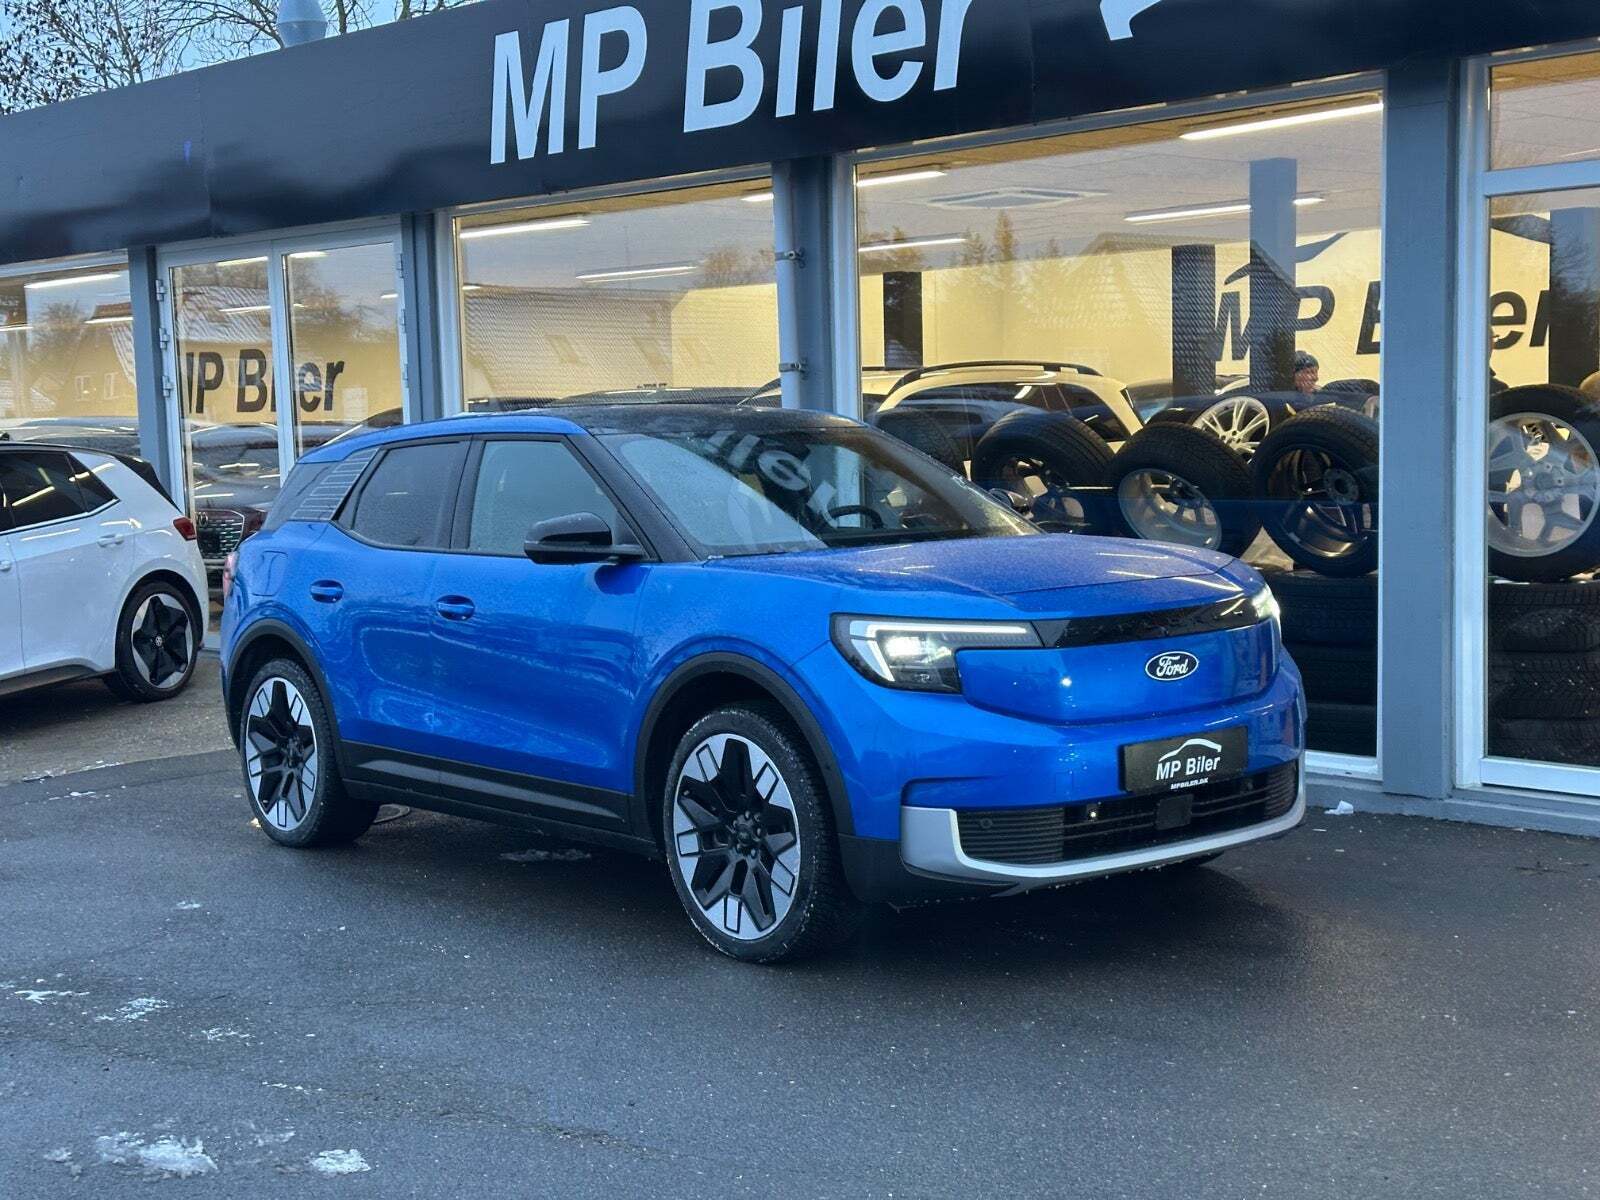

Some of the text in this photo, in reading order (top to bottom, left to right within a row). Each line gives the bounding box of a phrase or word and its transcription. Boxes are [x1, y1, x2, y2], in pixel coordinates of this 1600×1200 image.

[490, 0, 973, 164] MP Biler
[237, 348, 345, 413] Ber
[1156, 655, 1189, 677] Ford
[1156, 755, 1221, 780] MP Biler
